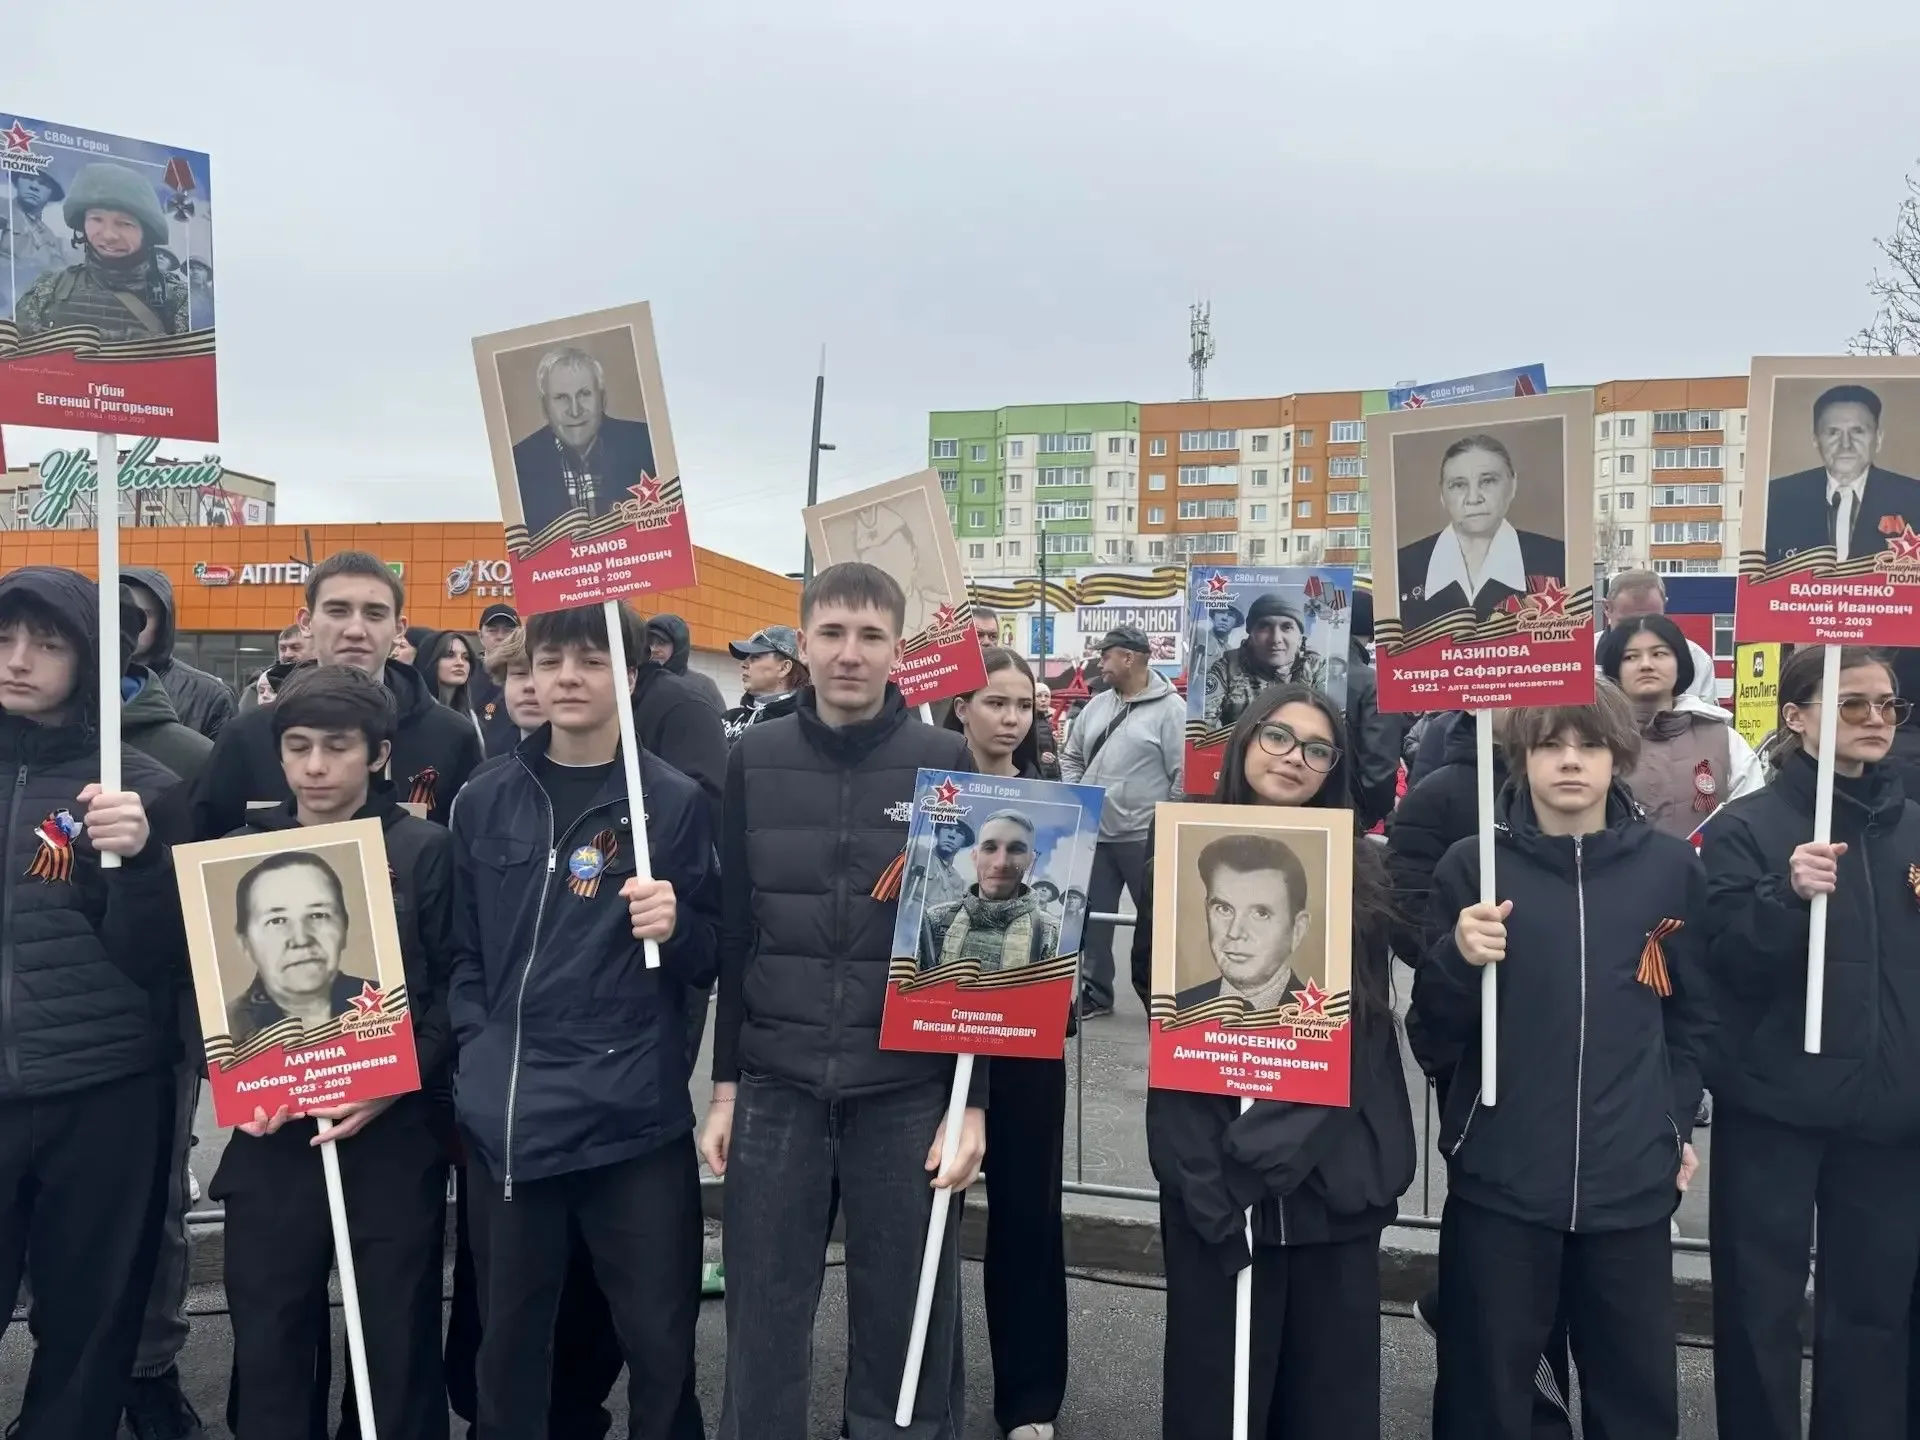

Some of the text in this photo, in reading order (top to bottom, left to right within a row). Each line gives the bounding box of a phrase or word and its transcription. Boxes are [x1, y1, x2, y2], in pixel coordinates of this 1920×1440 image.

[76, 136, 110, 153] Герои
[2, 159, 37, 173] ПОЛК
[88, 382, 125, 398] Губин
[37, 392, 91, 409] Евгений
[94, 398, 174, 417] Григорьевич
[638, 515, 668, 530] ПОЛК
[570, 538, 628, 559] ХРАМОВ
[531, 550, 672, 584] Александр Иванович
[575, 576, 600, 588] 1918
[607, 570, 632, 582] 2009
[559, 581, 651, 603] Рядовой, водитель
[1790, 583, 1895, 598] ВДОВИЧЕНКО
[1769, 600, 1913, 615] Василий Иванович
[1080, 609, 1177, 632] МИНИ-РЫНОК
[1808, 616, 1837, 626] 1926
[1845, 617, 1873, 627] 2003
[939, 633, 963, 645] ПОЛК
[1535, 630, 1570, 641] ПОЛК
[1816, 628, 1864, 639] Рядовой
[1441, 645, 1530, 661] НАЗИПОВА
[889, 653, 942, 676] АПЕНКО
[1392, 661, 1582, 682] Хатира Сафаргалеевна
[898, 664, 959, 686] Гаврилович
[1410, 683, 1440, 693] 1921
[1447, 683, 1469, 692] дата
[1471, 682, 1506, 692] смерти
[1508, 678, 1564, 688] неизвестна
[1739, 681, 1777, 699] АвтоЛига
[1462, 693, 1512, 704] Рядовая
[994, 785, 1020, 797] Герои
[930, 813, 956, 823] ПОЛК
[951, 1008, 1004, 1022] Стуколов
[358, 1026, 392, 1040] ПОЛК
[912, 1019, 1037, 1038] Максим Александрович
[1295, 1028, 1329, 1039] ПОЛК
[1204, 1031, 1297, 1050] МОИСЕЕНКО
[285, 1045, 347, 1068] ЛАРИНА
[1173, 1045, 1329, 1071] Дмитрий Романович
[236, 1054, 398, 1093] Любовь Дмитриевна
[1219, 1066, 1246, 1077] 1913
[1254, 1069, 1281, 1080] 1985
[288, 1083, 317, 1097] 1923
[324, 1077, 352, 1090] 2003
[1226, 1079, 1273, 1092] Рядовой
[298, 1091, 346, 1106] Рядовая
